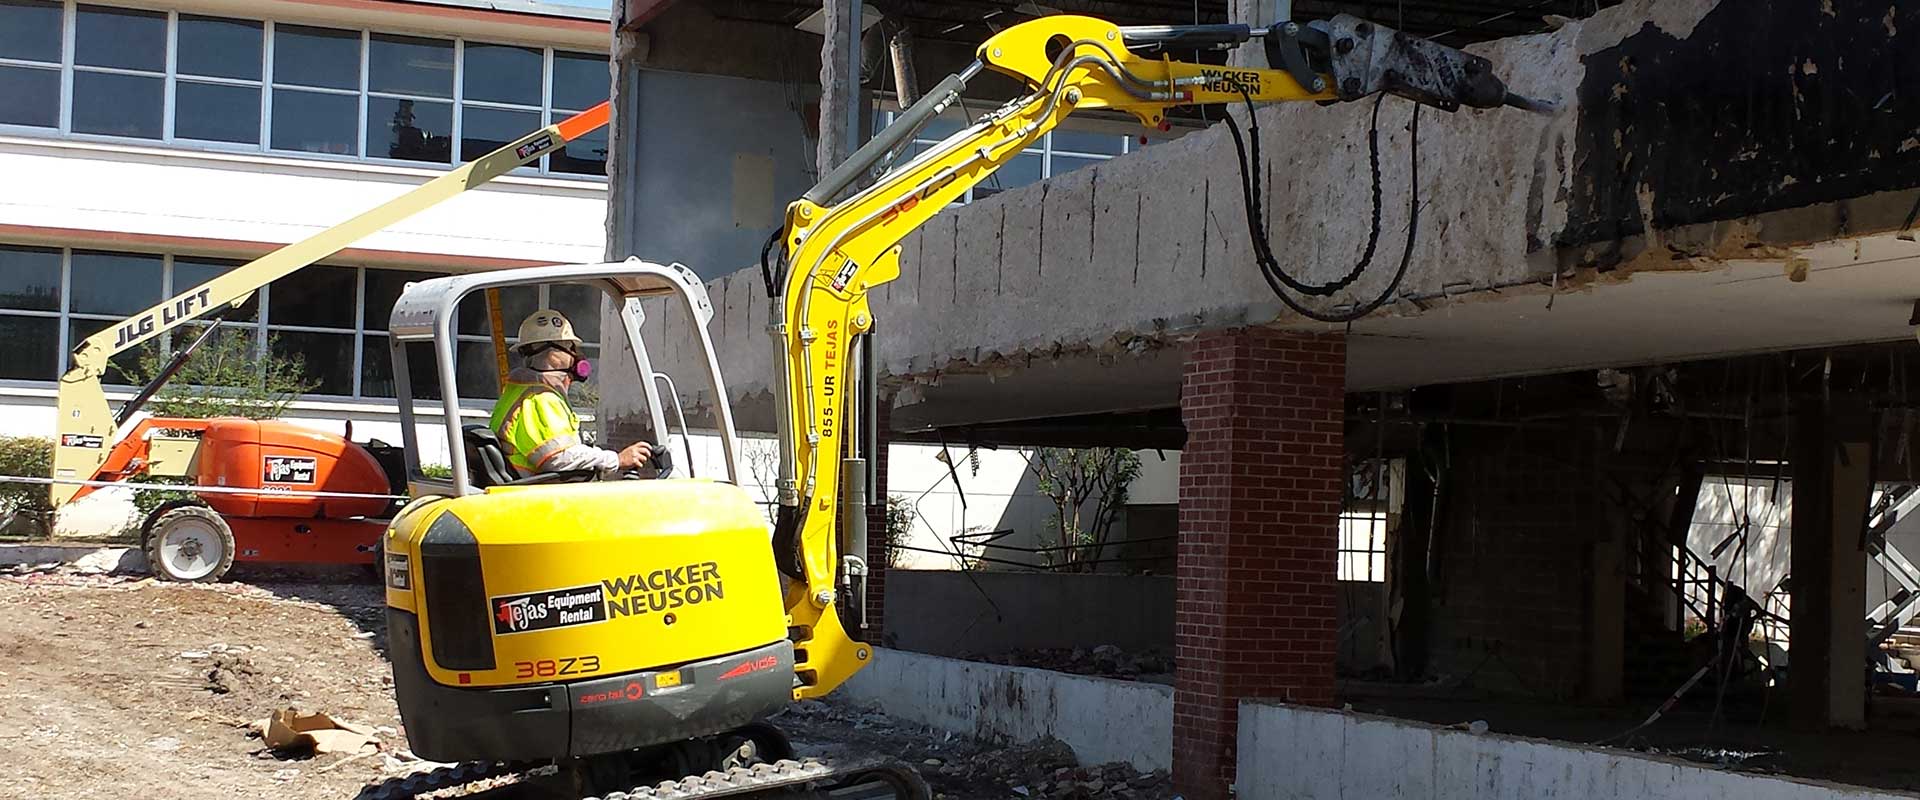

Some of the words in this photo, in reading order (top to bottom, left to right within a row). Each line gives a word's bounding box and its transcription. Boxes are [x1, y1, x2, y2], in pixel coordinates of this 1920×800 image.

[1200, 69, 1260, 83] WACKER
[114, 314, 154, 349] JLG
[162, 288, 210, 325] LIFT
[825, 320, 838, 370] TEJAS
[822, 375, 835, 437] 855-UR
[602, 561, 721, 597] WACKER
[499, 597, 548, 631] Tejas
[547, 588, 601, 610] Equipment
[559, 606, 593, 624] Rental
[608, 581, 724, 619] NEUSON
[515, 655, 601, 679] 38Z3
